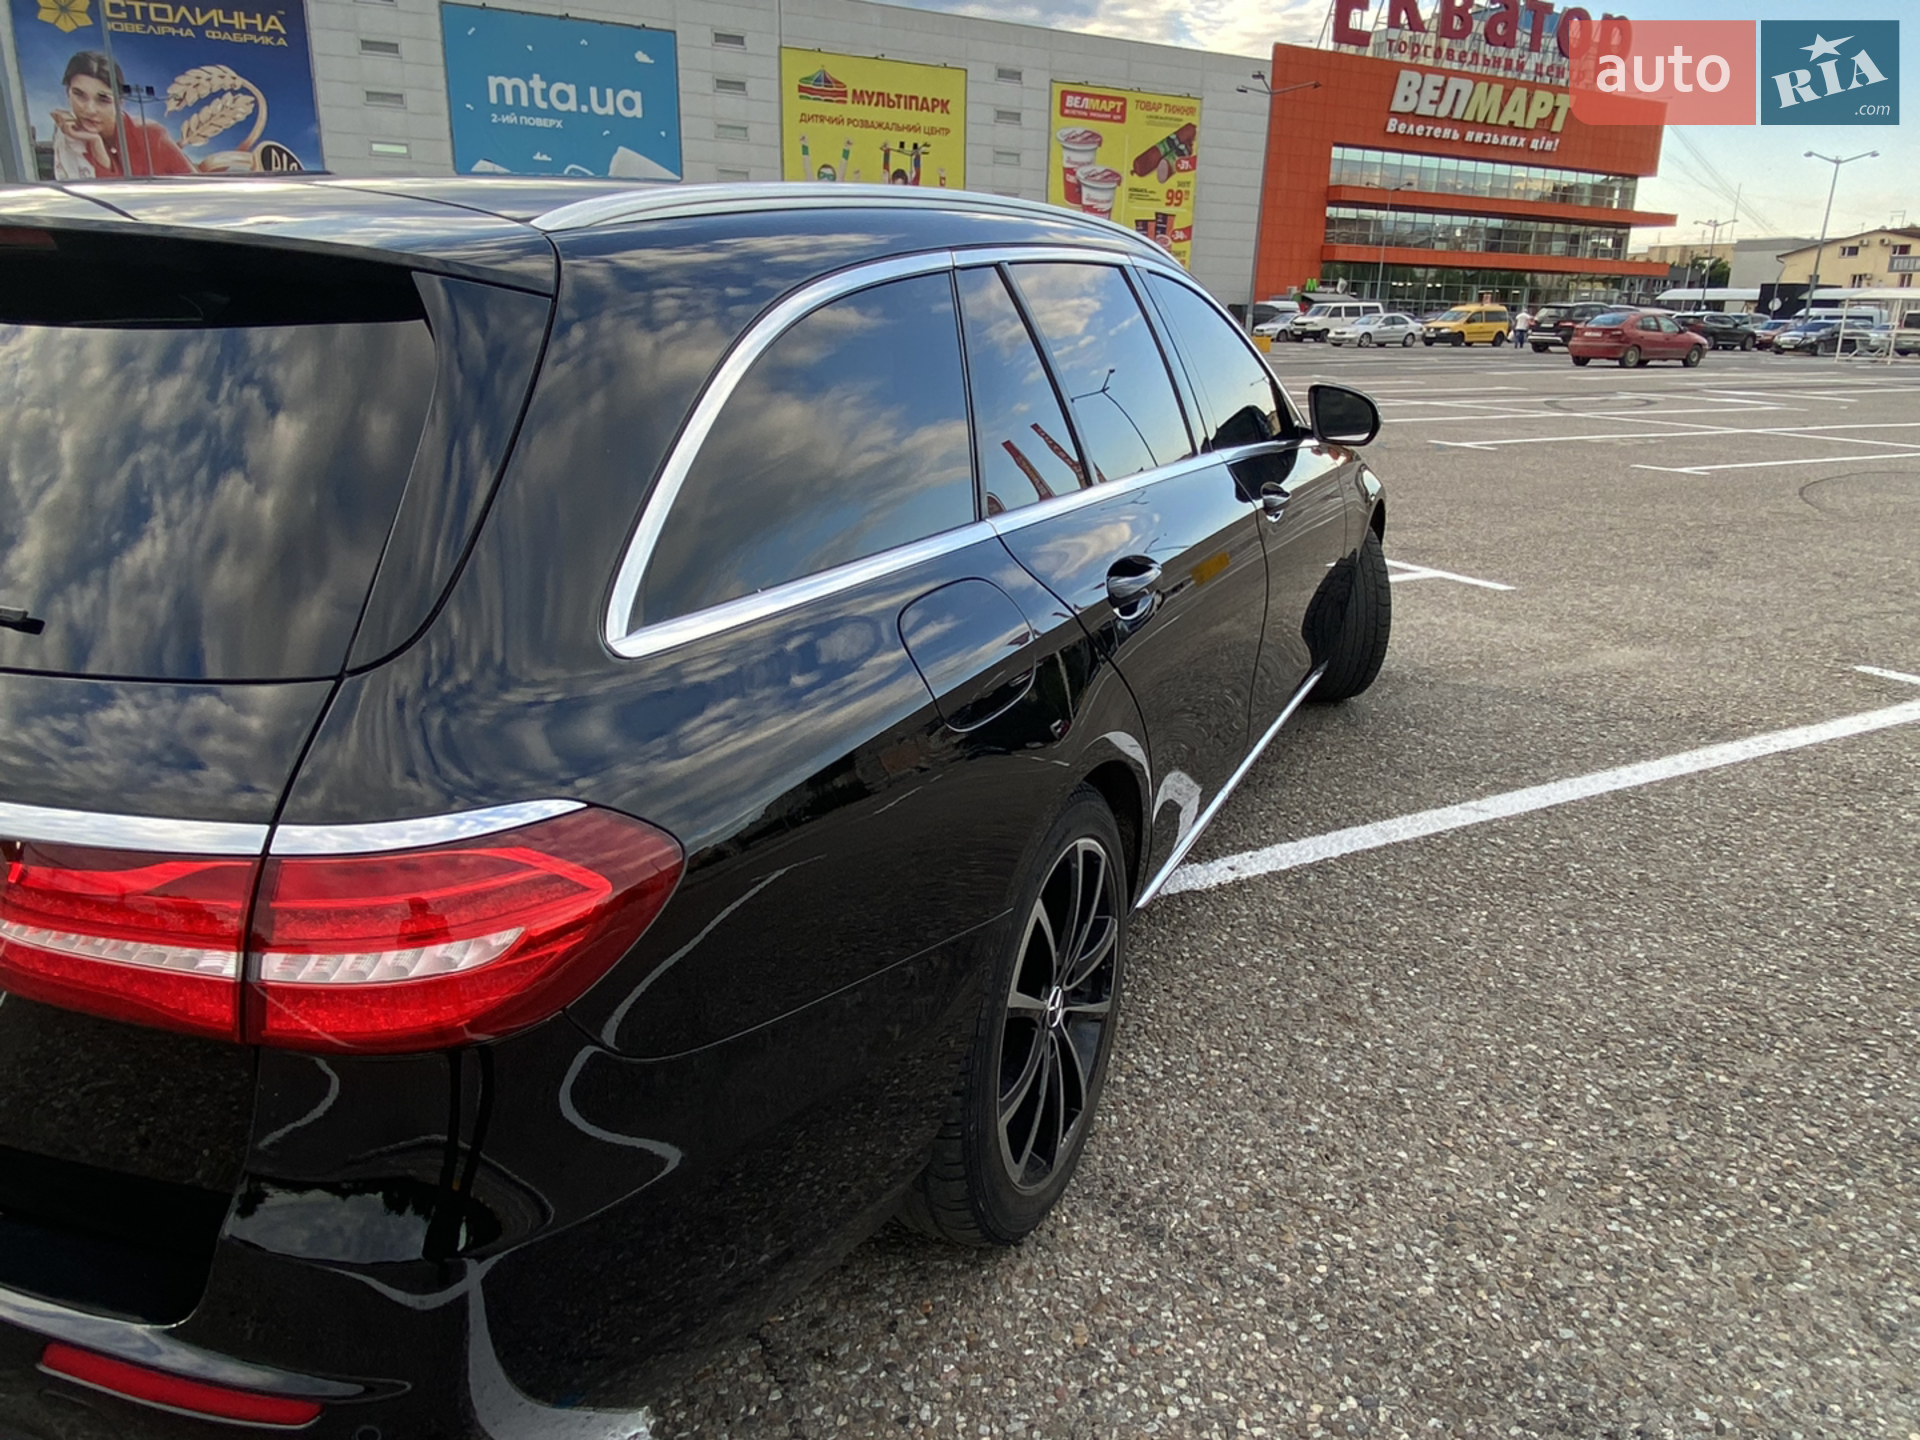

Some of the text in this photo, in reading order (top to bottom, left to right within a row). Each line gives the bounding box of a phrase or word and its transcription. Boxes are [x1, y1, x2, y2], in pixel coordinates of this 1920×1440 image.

[105, 0, 287, 34] СТОЛИЧНА
[206, 30, 288, 47] ФАБРИКА
[488, 73, 643, 118] mta.ua
[851, 89, 951, 115] МУЛЬТІПАРК
[1065, 95, 1124, 113] ВЕЛМАРТ
[1135, 99, 1163, 113] ТОВАР
[1389, 69, 1576, 133] ВЕЛМАРТ
[491, 113, 563, 129] 2-ИЙ ПОВЕРХ
[799, 112, 951, 137] ДИТЯЧИЙ РОЗВАЖАЛЬНИЙ ЦЕНТР
[1386, 117, 1460, 141] Велетень
[1464, 130, 1527, 149] низьких
